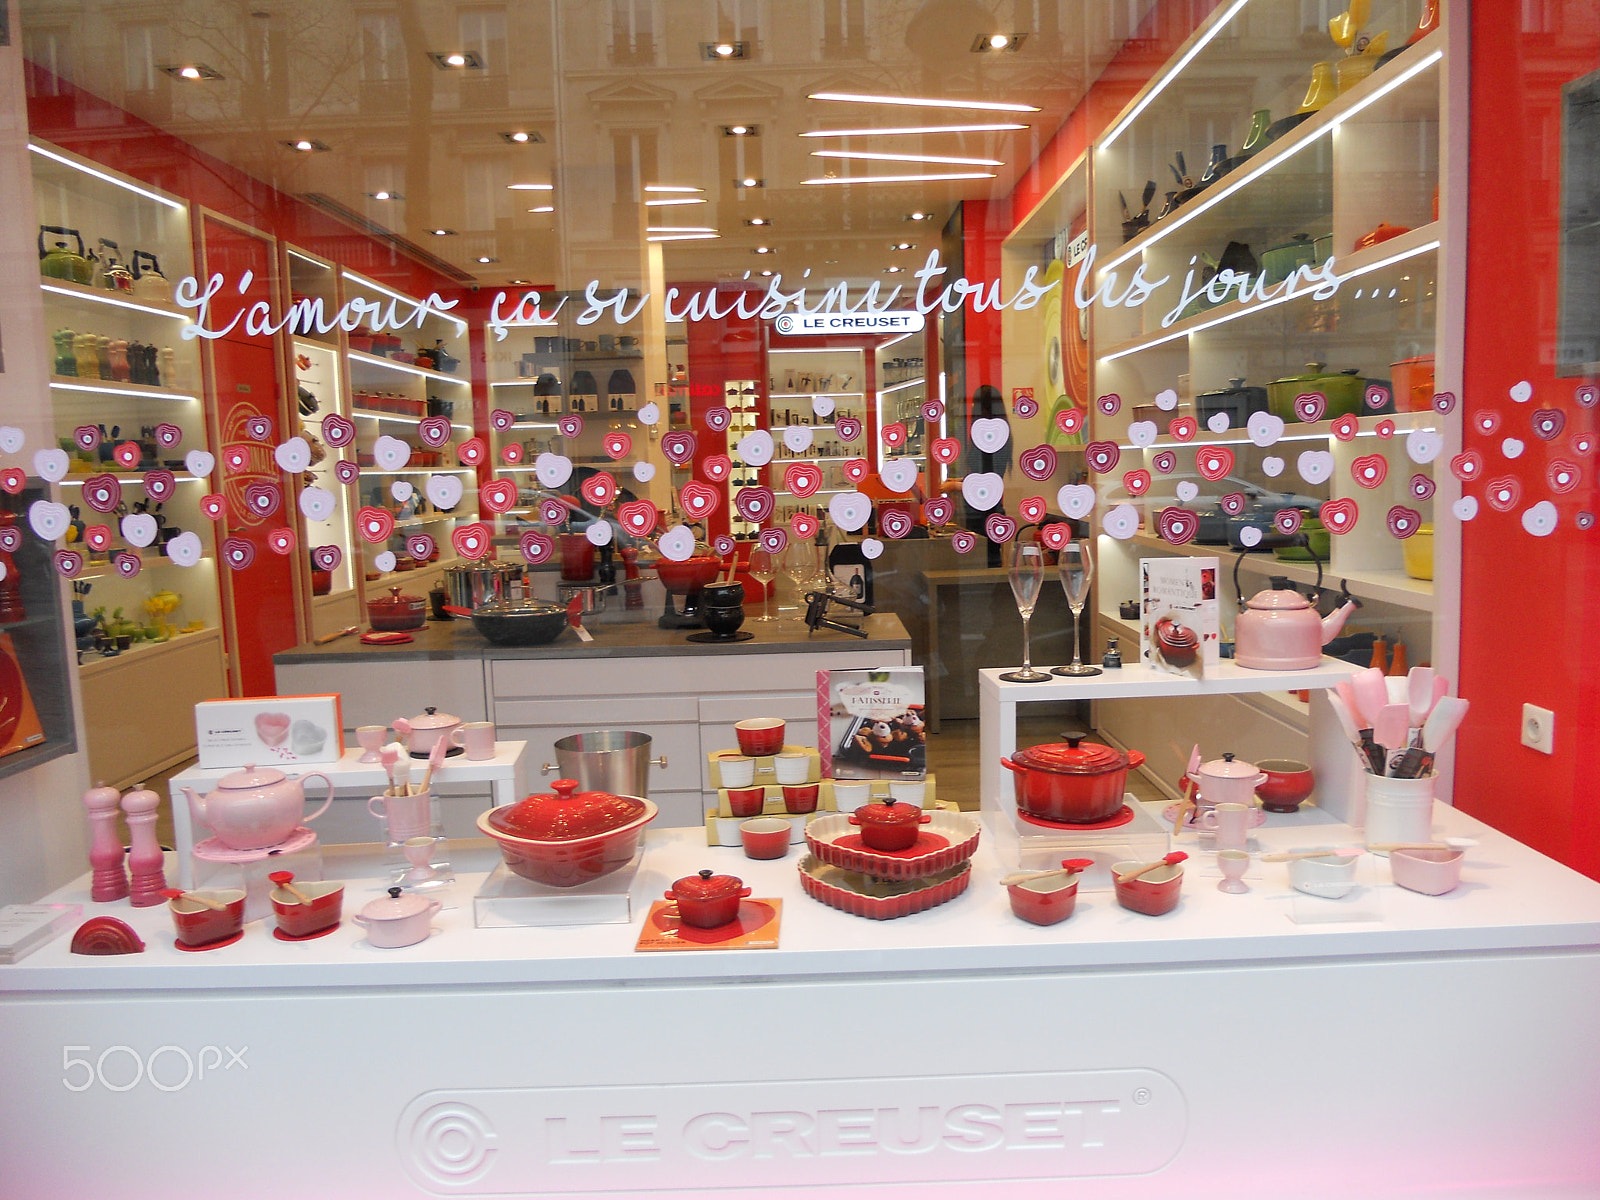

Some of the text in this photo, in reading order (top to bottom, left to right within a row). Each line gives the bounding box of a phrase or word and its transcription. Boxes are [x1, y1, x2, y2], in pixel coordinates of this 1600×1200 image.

[490, 290, 569, 342] ça
[576, 279, 651, 325] se
[664, 268, 903, 322] cuisine
[913, 248, 1060, 315] tous
[1073, 243, 1170, 309] les
[803, 316, 911, 328] LE CREUSET
[545, 1115, 662, 1166] LE
[682, 1099, 1121, 1163] CREUSET
